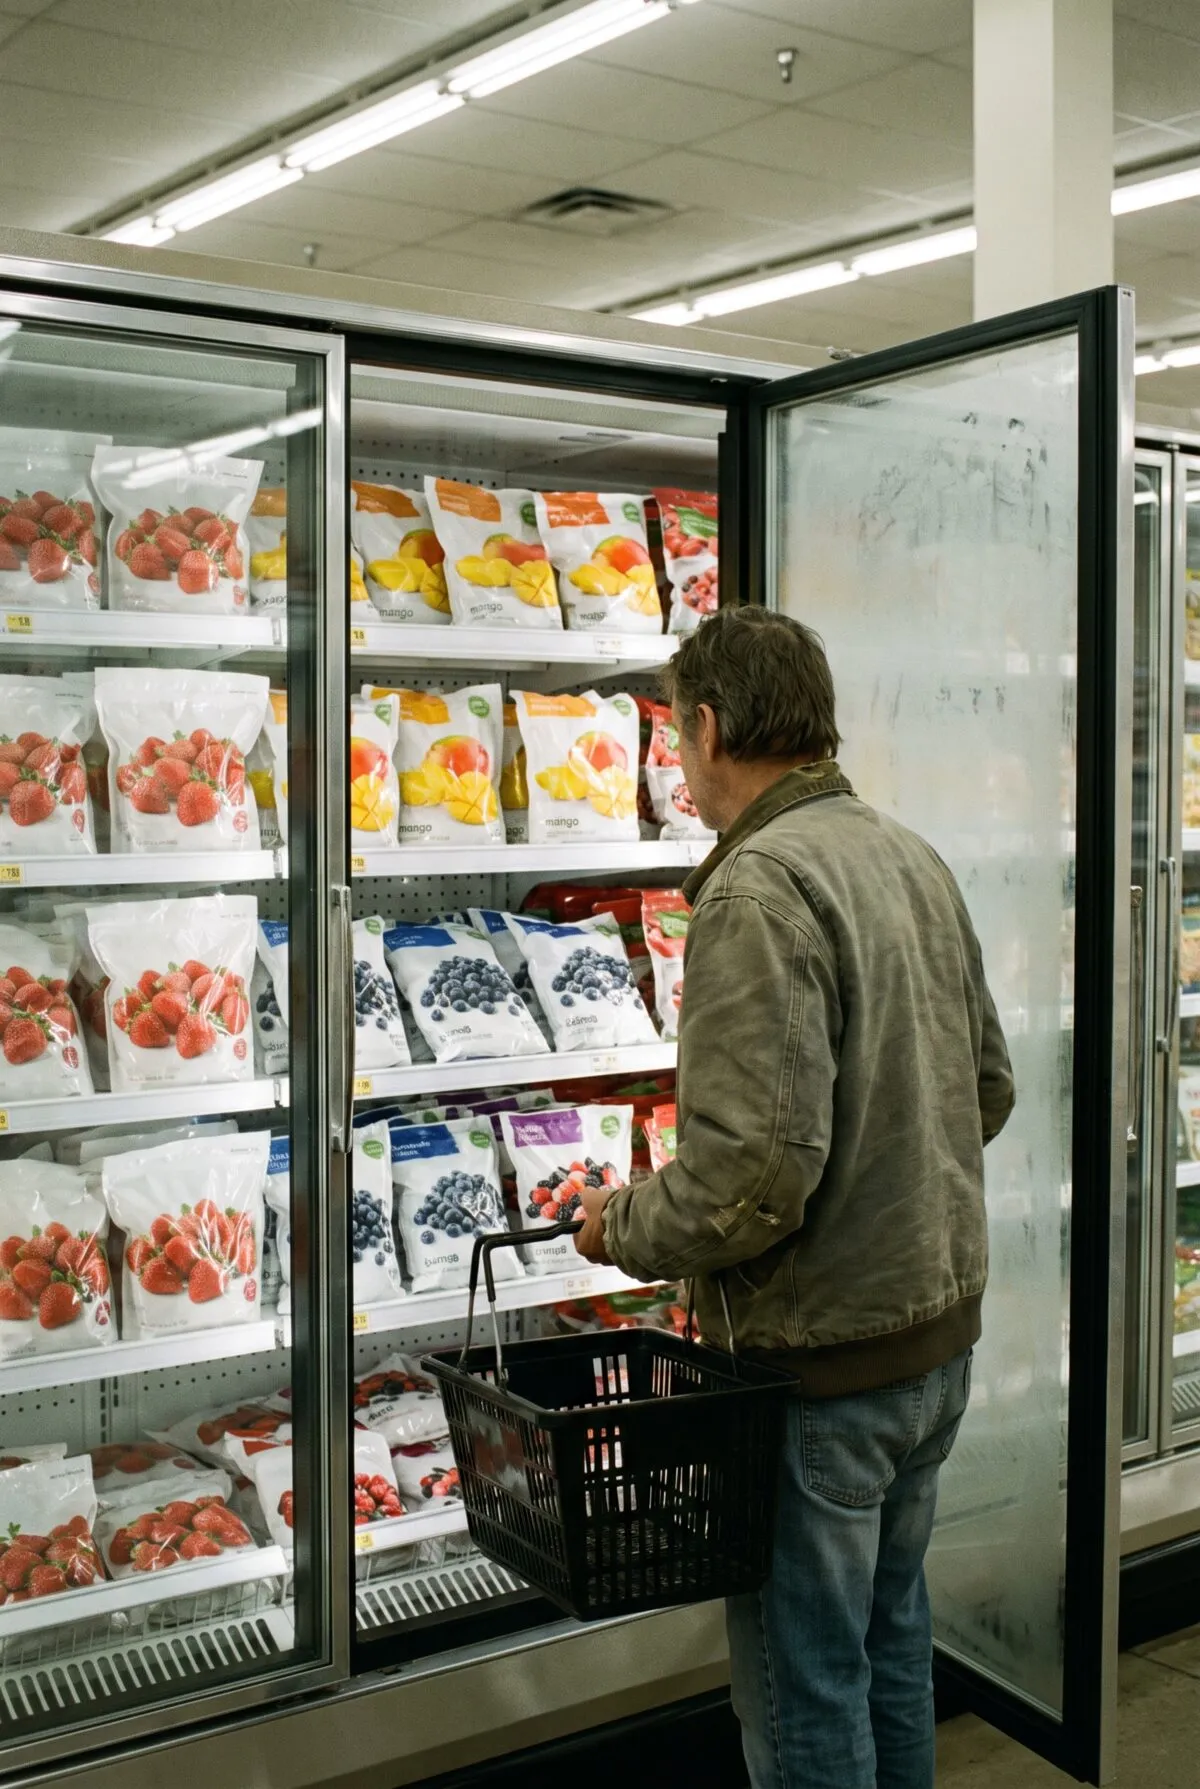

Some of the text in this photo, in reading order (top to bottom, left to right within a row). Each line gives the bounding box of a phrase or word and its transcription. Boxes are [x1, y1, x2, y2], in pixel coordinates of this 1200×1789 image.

[379, 607, 413, 620] mango
[545, 817, 579, 827] mango
[399, 823, 432, 834] mango
